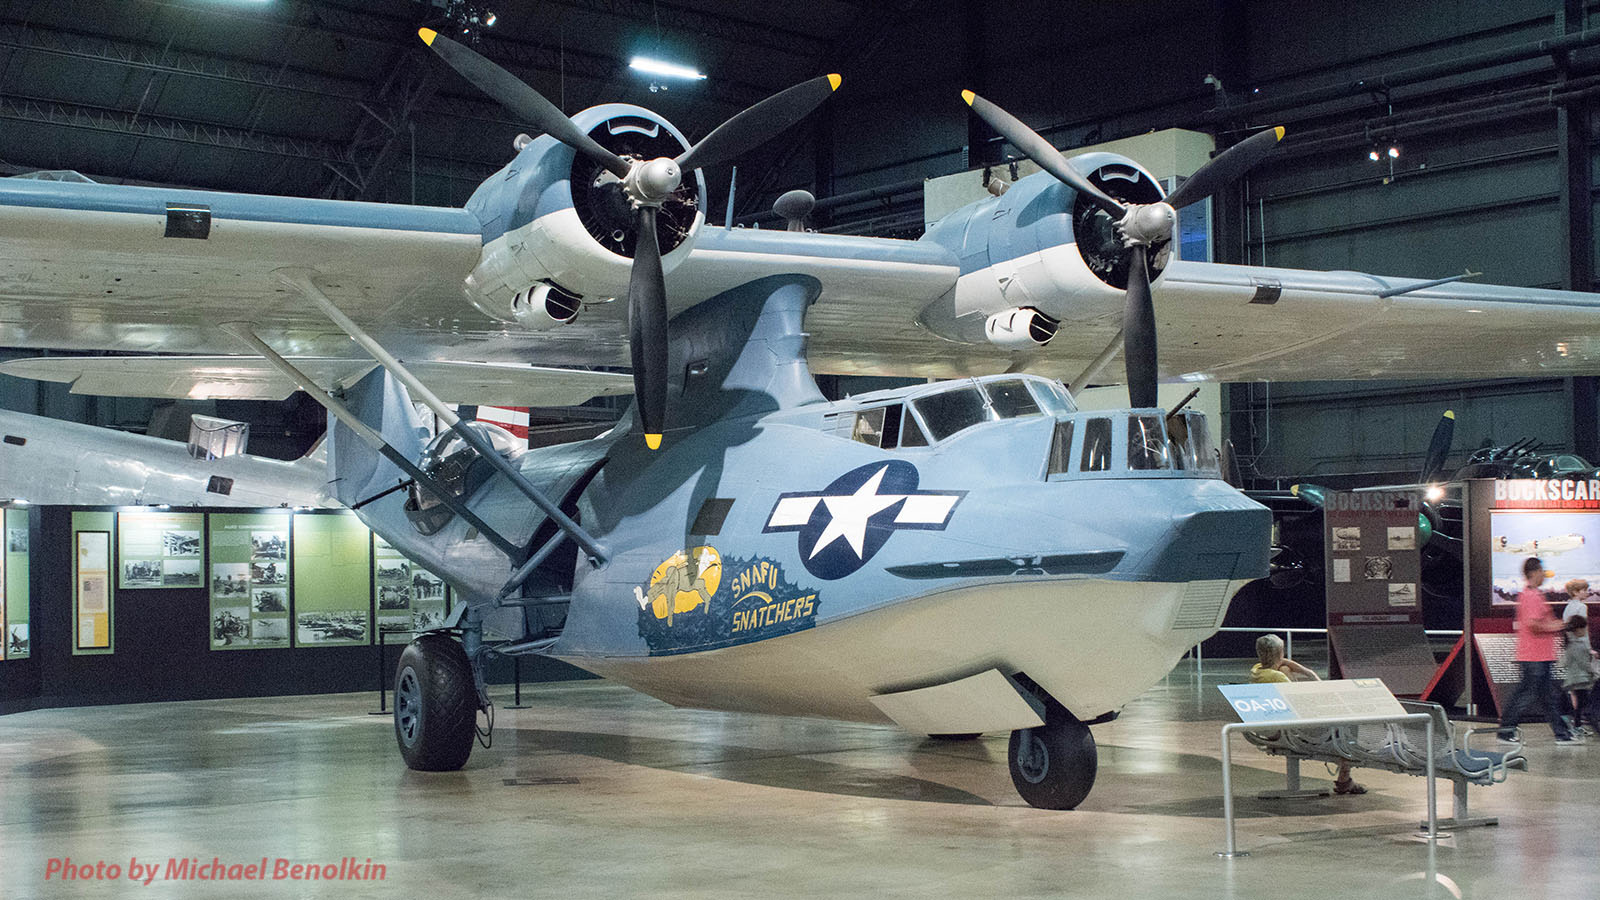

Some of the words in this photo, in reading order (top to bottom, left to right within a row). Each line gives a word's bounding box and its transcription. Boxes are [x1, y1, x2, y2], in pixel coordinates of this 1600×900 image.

[1495, 479, 1600, 500] BOCKSCAR
[731, 561, 778, 598] SNAFU
[731, 595, 816, 632] SNATCHERS
[1234, 698, 1288, 713] OA-10
